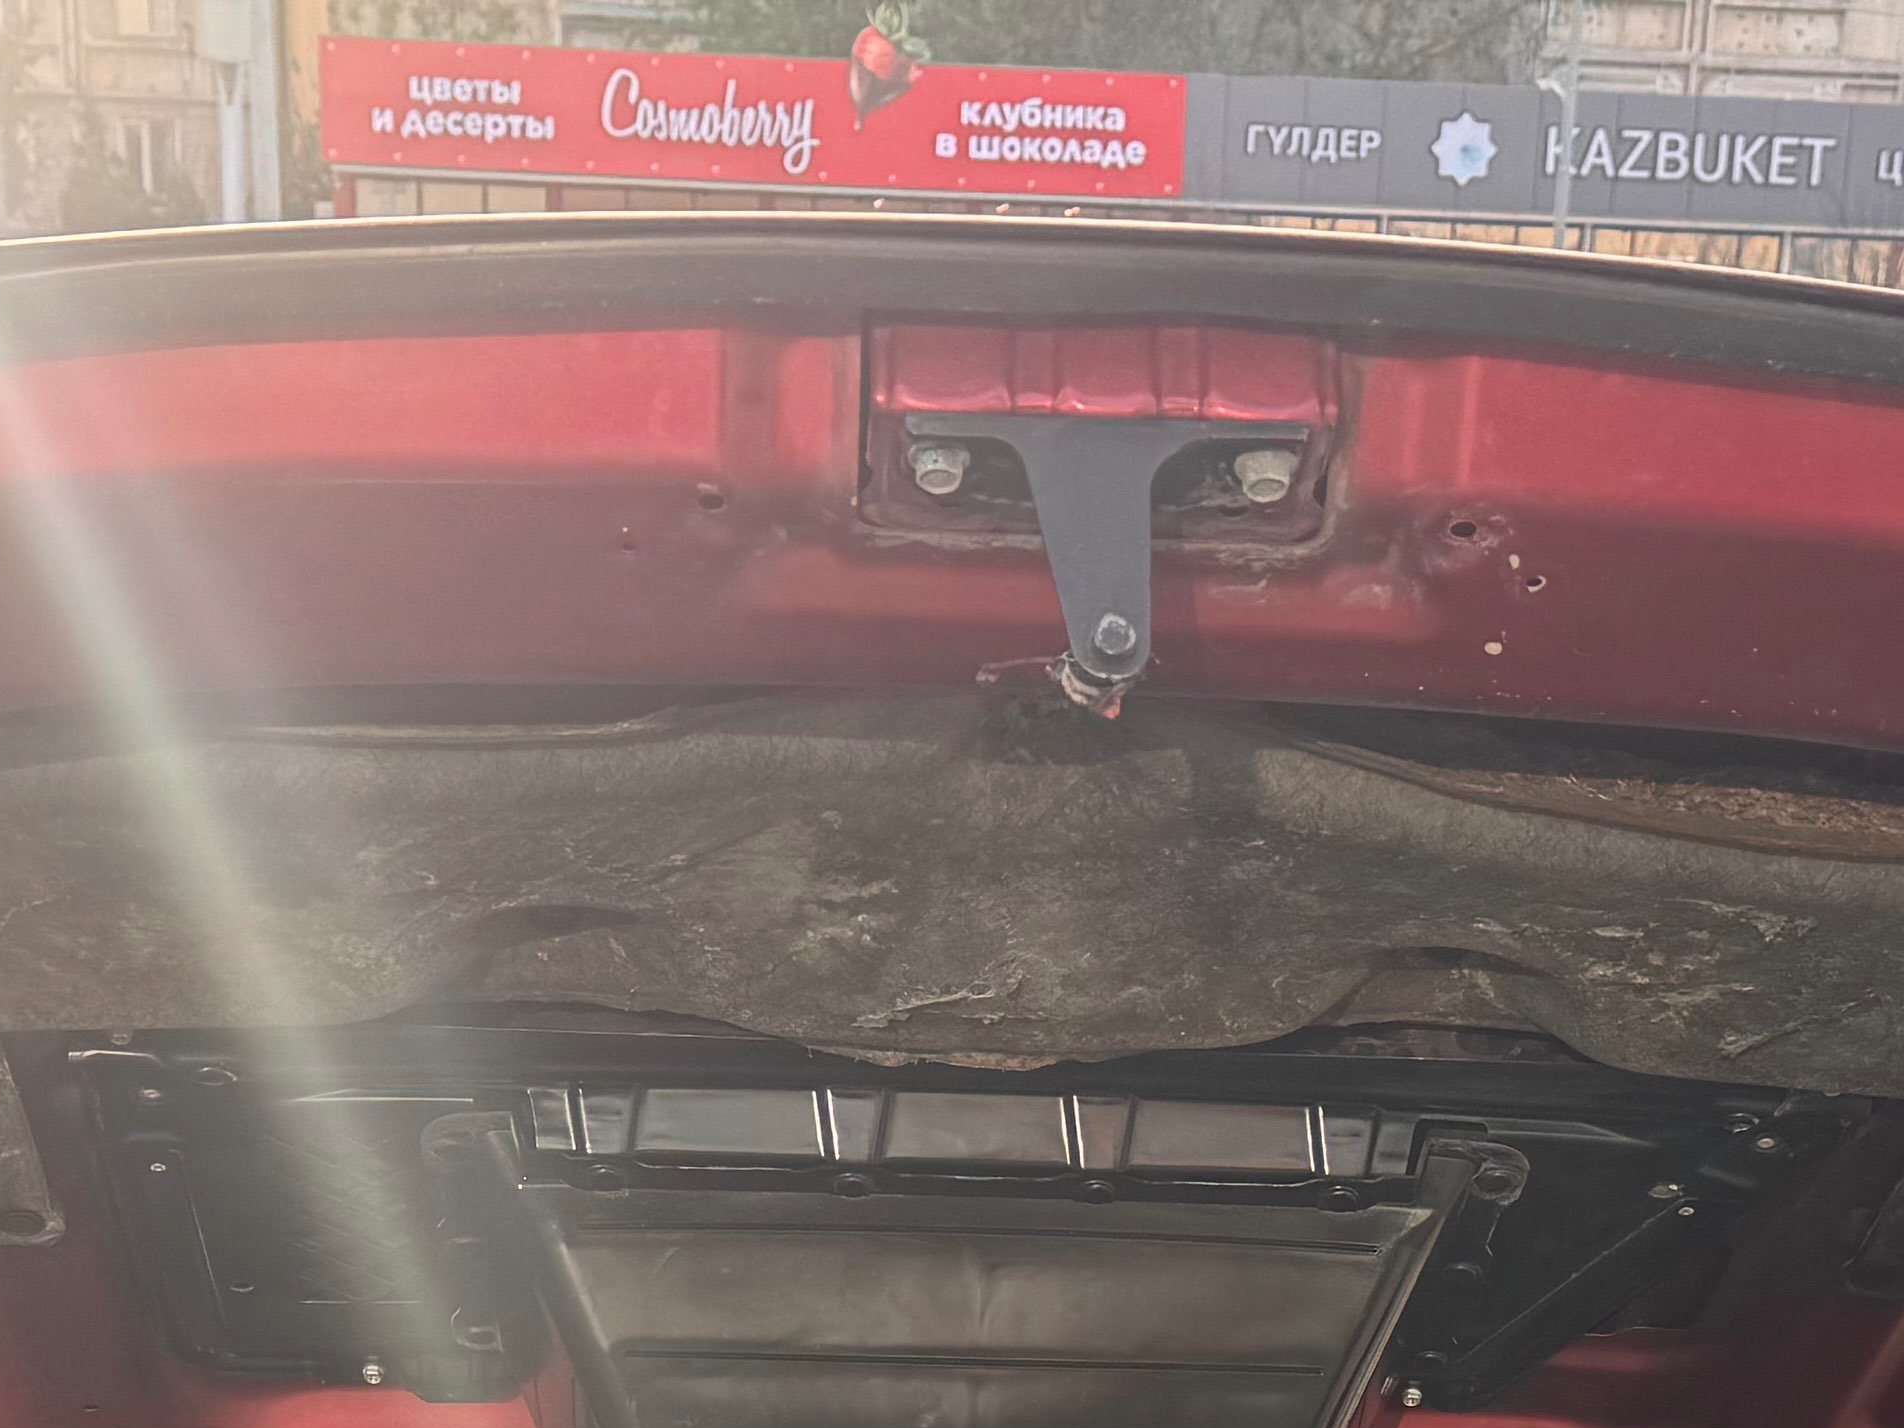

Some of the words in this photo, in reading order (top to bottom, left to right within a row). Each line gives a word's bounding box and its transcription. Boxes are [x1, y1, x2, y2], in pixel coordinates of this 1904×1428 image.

[408, 74, 522, 105] цветы
[371, 107, 393, 133] и
[401, 108, 555, 143] десерты
[601, 68, 822, 175] Cosmoberry
[960, 97, 1127, 131] клубника
[935, 134, 958, 159] в
[968, 134, 1148, 169] шоколаде
[1544, 125, 1838, 187] KAZBUKET
